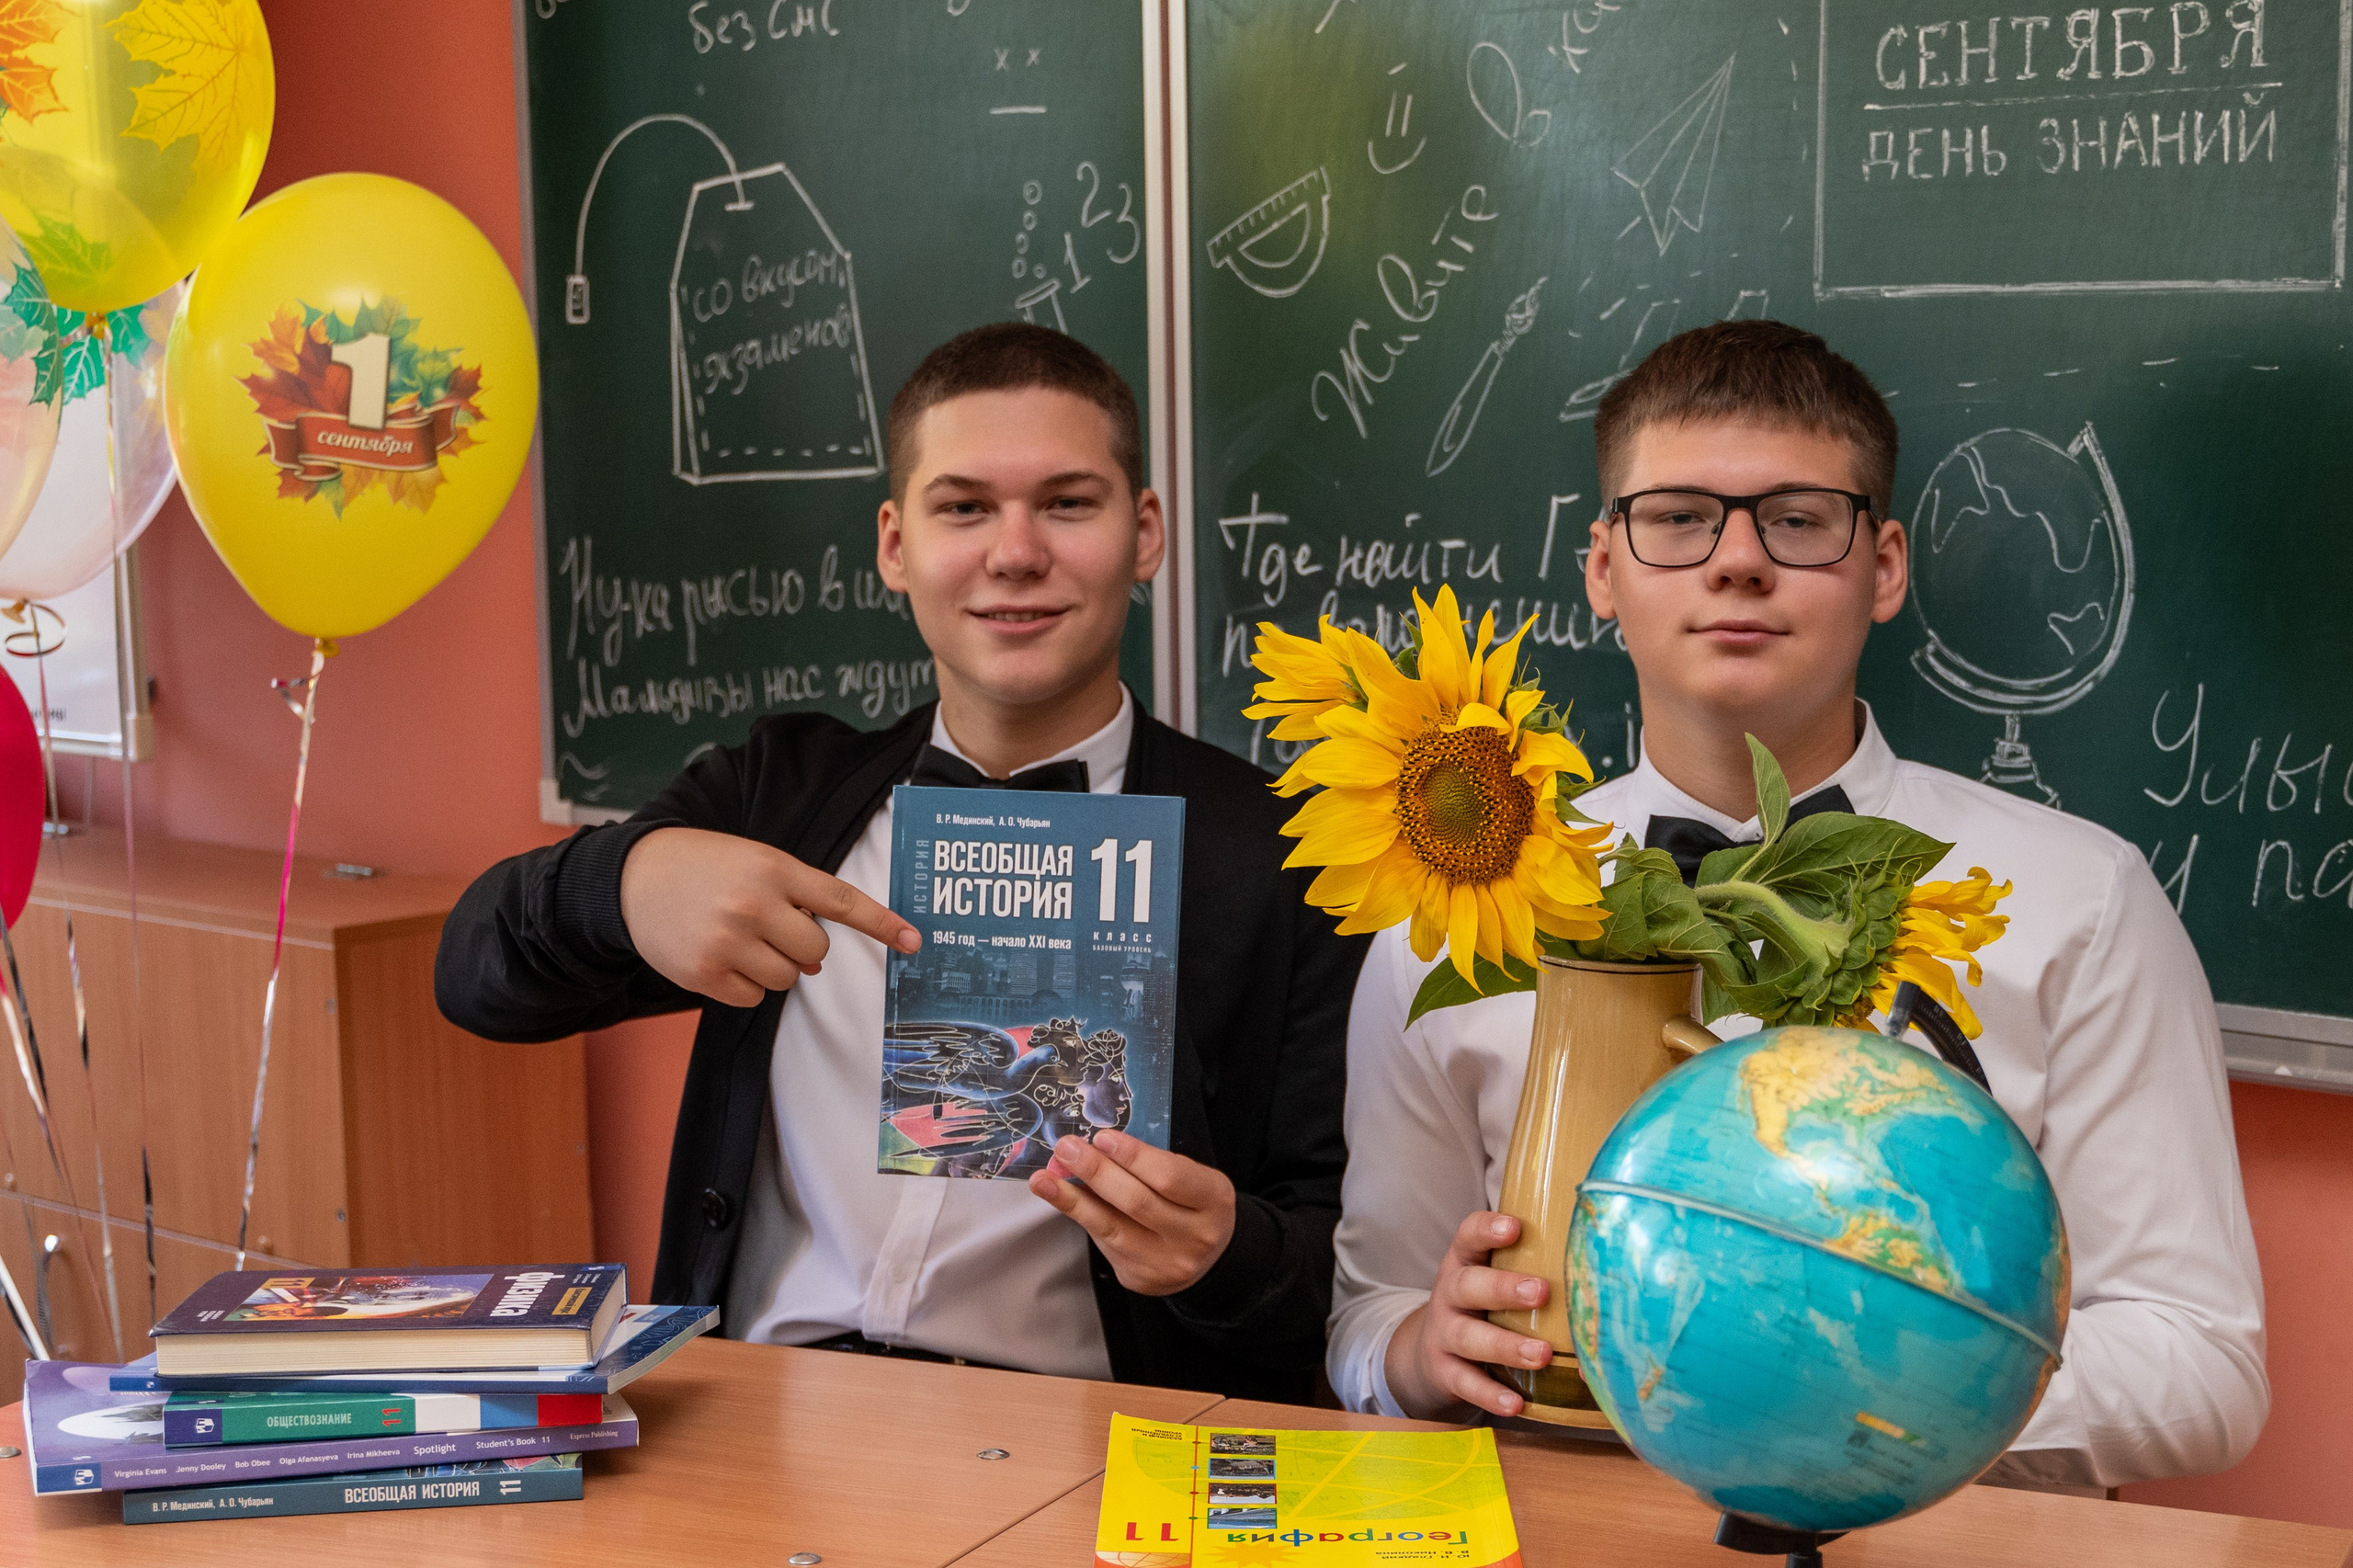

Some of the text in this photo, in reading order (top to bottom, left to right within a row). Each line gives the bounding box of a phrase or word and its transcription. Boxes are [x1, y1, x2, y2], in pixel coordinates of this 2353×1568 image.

[689, 0, 756, 54] без
[1875, 0, 2269, 91] СЕНТЯБРЯ
[1861, 92, 2278, 182] ДЕНЬ ЗНАНИЙ
[332, 333, 389, 429] 1
[316, 430, 415, 458] сентября
[1336, 512, 1505, 587] найти
[680, 566, 805, 667] рысью
[817, 543, 846, 612] в
[562, 656, 935, 739] Мальдивы нас ждут
[2143, 682, 2353, 814] Улы
[936, 813, 1051, 828] В. Р. Мединский, А. О. Чубарьян
[913, 839, 930, 915] ИСТОРИЯ
[934, 840, 1074, 881] ВСЕОБЩАЯ
[1091, 838, 1153, 923] 11
[932, 876, 1073, 920] ИСТОРИЯ
[932, 931, 956, 945] 1945
[958, 934, 975, 947] год
[991, 936, 1026, 948] начало
[1029, 935, 1046, 949] XXI
[1048, 938, 1072, 949] века
[1092, 944, 1122, 952] БАЗОВЫЙ
[489, 1272, 565, 1317] физика
[267, 1407, 402, 1428] ОБЩЕСТВОЗНАНИЕ 11
[114, 1470, 143, 1479] Virginia
[145, 1467, 167, 1475] Evans
[176, 1466, 199, 1474] Jenny
[200, 1462, 227, 1471] Dooley
[279, 1457, 296, 1465] Olga
[298, 1454, 339, 1463] Afanasyeva
[366, 1449, 401, 1458] Mikheeva
[414, 1444, 457, 1456] Spotlight
[517, 1437, 537, 1446] Book
[541, 1436, 551, 1444] 11
[570, 1432, 590, 1440] Express
[591, 1429, 619, 1438] Publishing
[153, 1479, 522, 1512] В. Р. Мединский, А. О. Чубарьян ВСЕОБЩАЯ ИСТОРИЯ 11
[1124, 1521, 1181, 1542] 11
[1227, 1528, 1469, 1547] География
